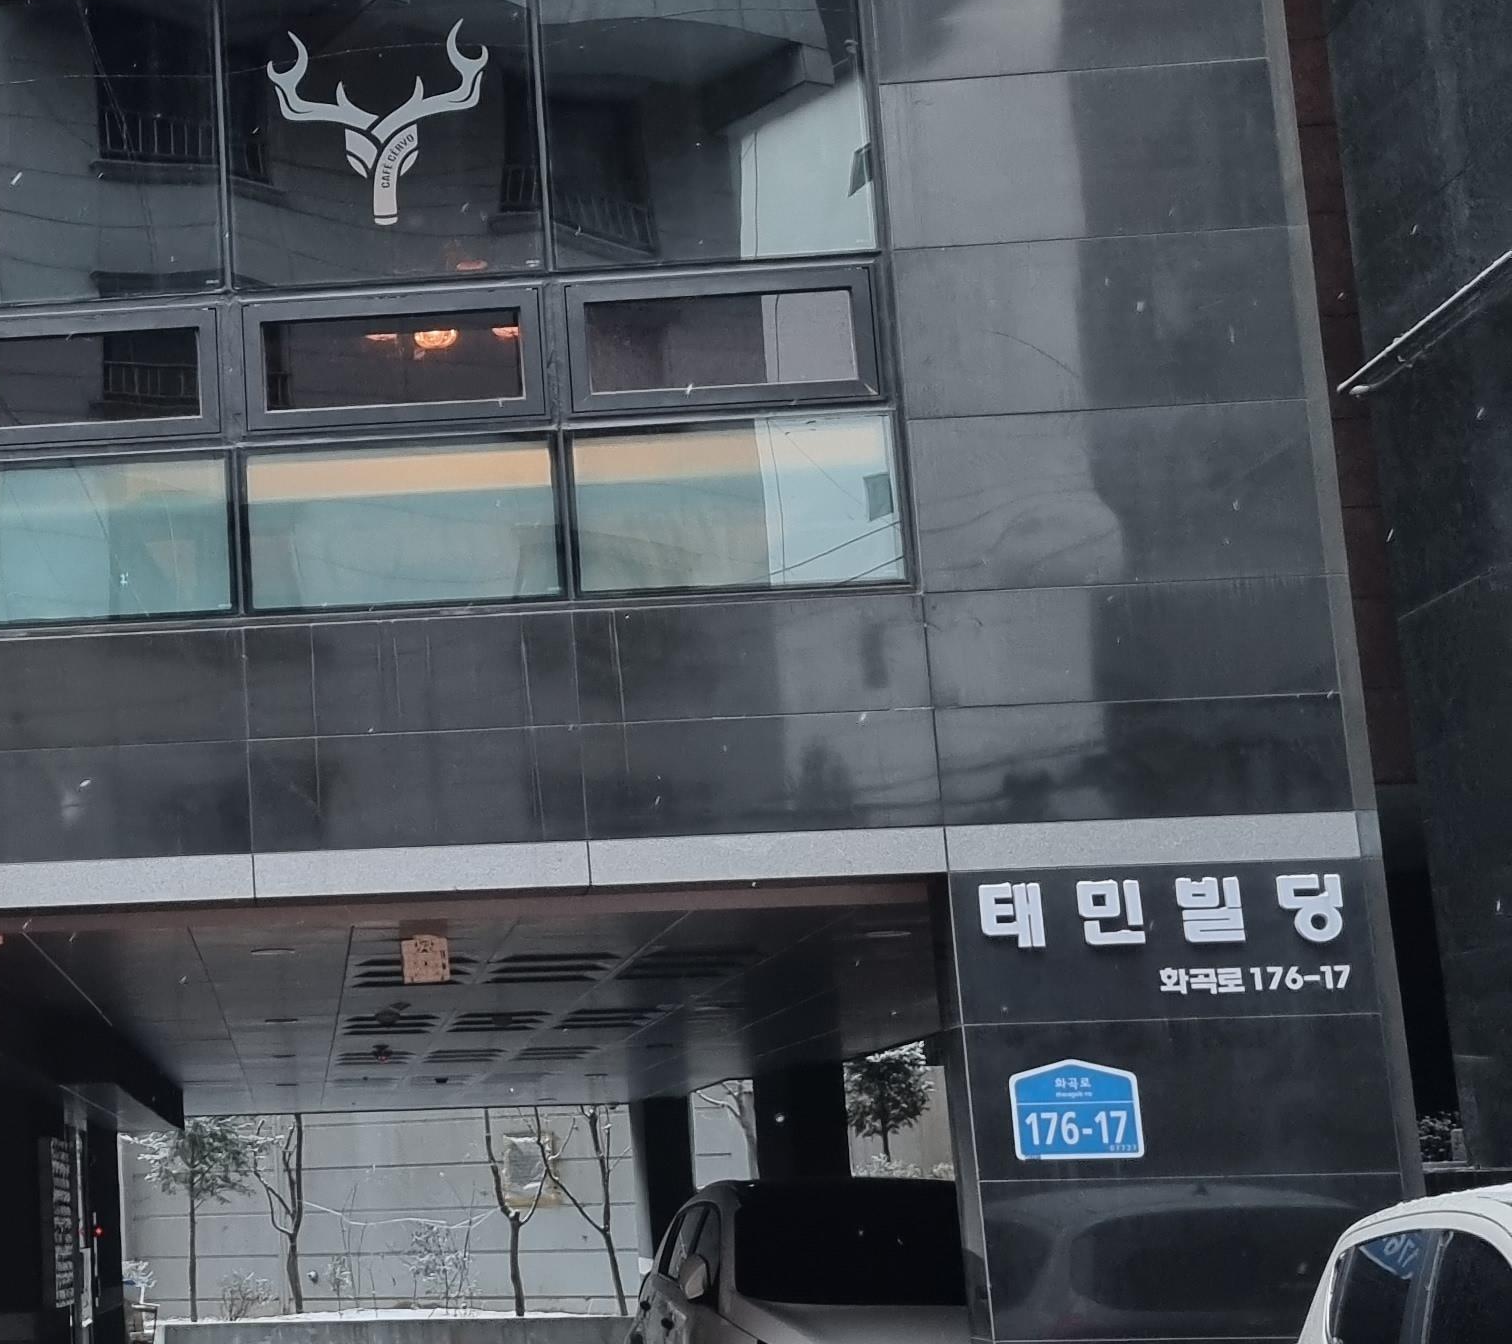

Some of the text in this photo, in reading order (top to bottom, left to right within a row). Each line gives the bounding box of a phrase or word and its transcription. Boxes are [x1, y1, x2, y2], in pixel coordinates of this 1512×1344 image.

[978, 873, 1343, 949] 태민빌딩
[1159, 964, 1351, 994] 화곡로 176-17
[1054, 1077, 1092, 1090] 화곡로
[1025, 1110, 1128, 1145] 176-17
